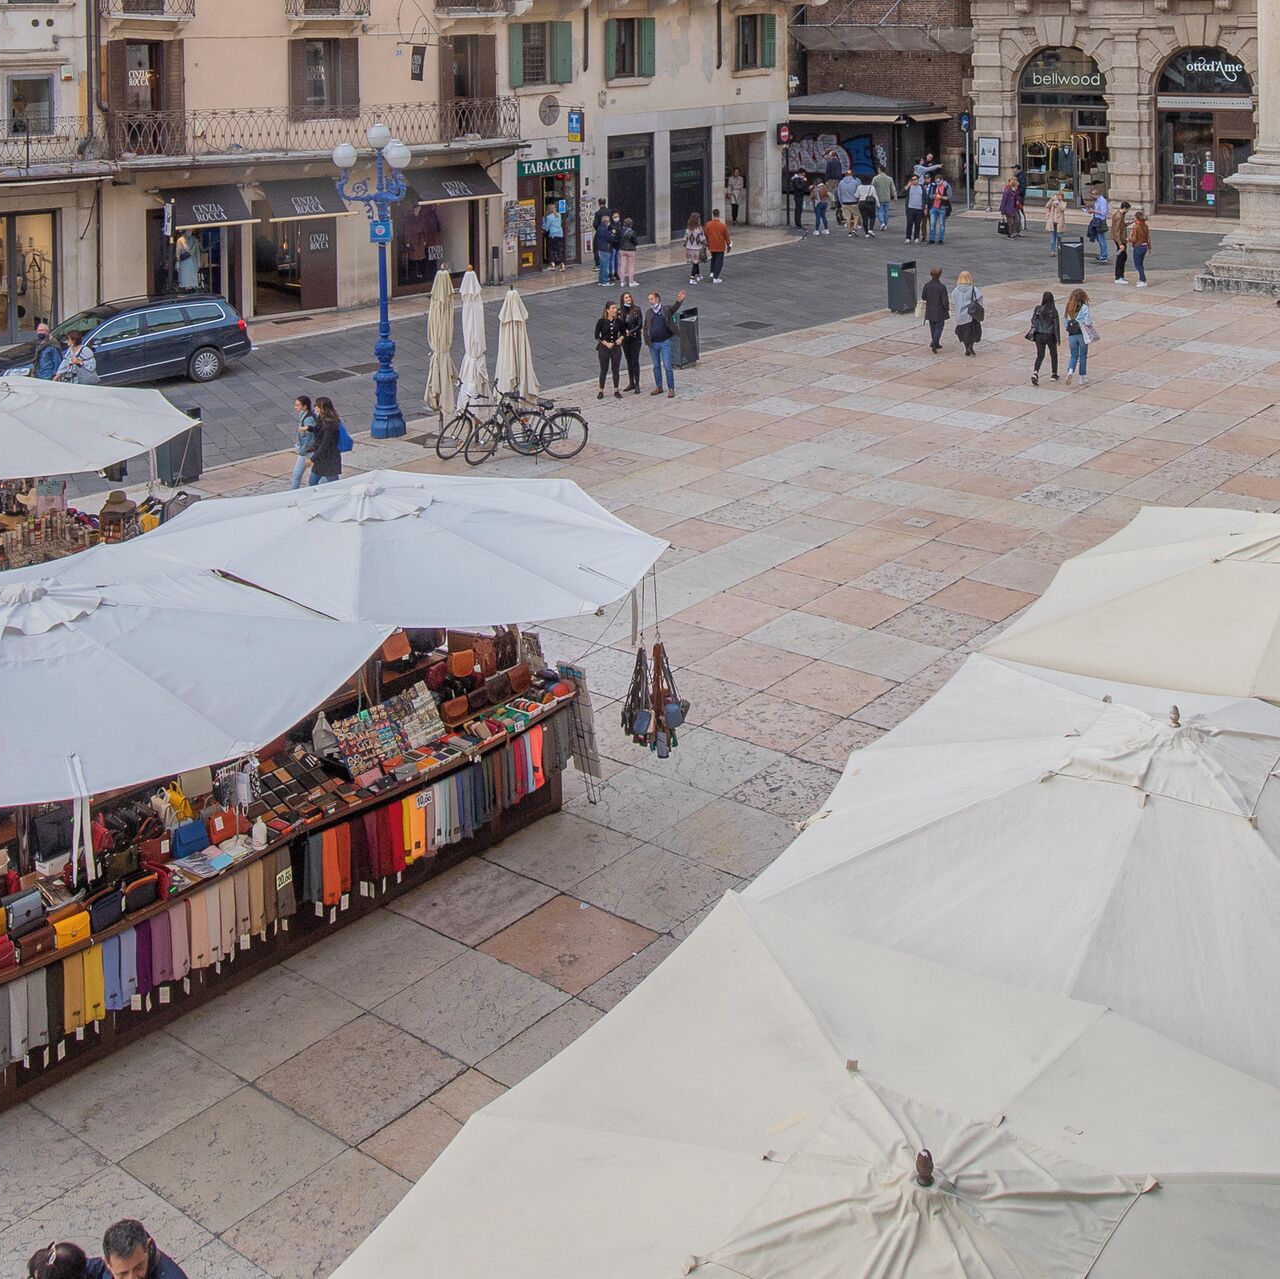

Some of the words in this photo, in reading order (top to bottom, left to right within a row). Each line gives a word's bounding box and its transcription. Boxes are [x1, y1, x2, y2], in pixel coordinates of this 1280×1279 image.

[128, 70, 149, 78] CINZIA
[128, 78, 150, 86] ROCCA
[1033, 73, 1101, 86] bellwood
[523, 158, 575, 175] TABACCHI
[442, 180, 468, 189] CINZIA
[446, 188, 473, 197] ROCCA
[292, 196, 322, 206] CINZIA
[192, 203, 225, 213] CINZIA
[295, 204, 325, 214] ROCCA
[196, 211, 228, 222] ROCCA
[309, 233, 329, 242] CINZIA
[309, 242, 329, 250] ROCCA
[428, 245, 443, 253] CINZIA
[428, 252, 444, 260] ROCCA
